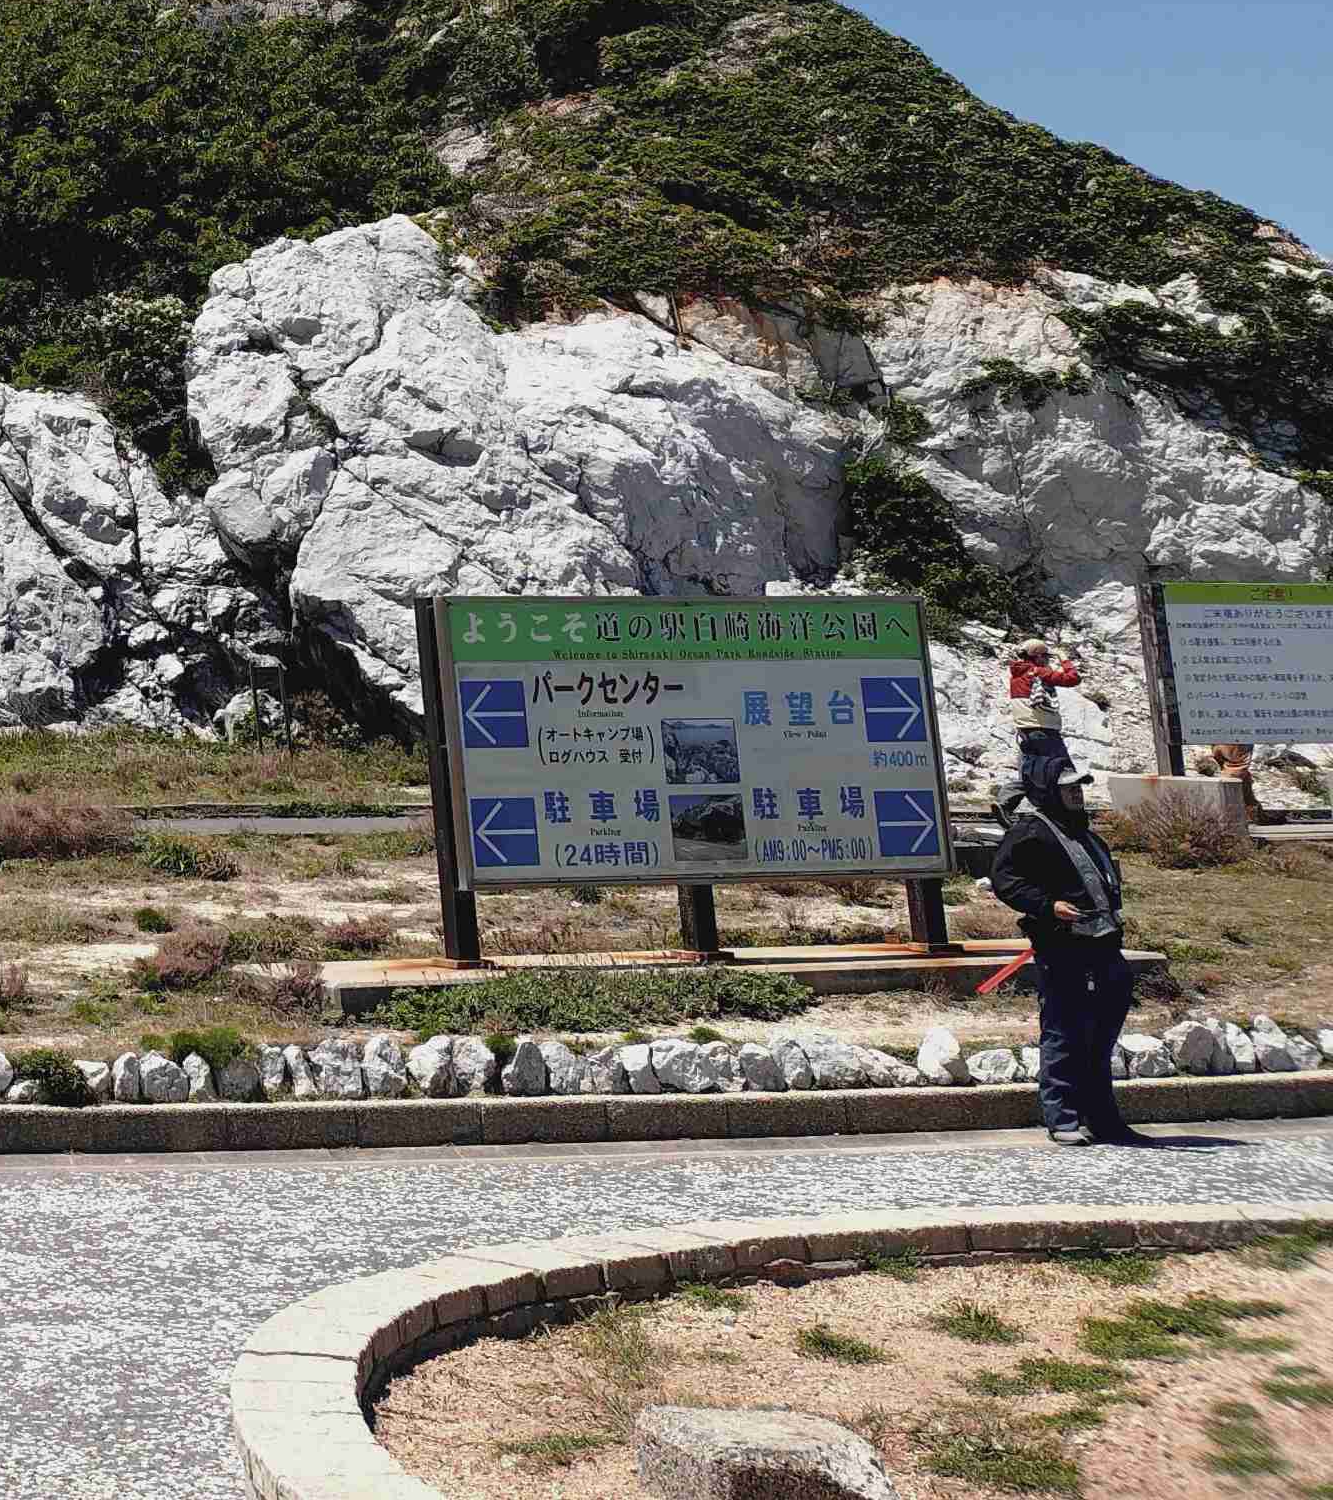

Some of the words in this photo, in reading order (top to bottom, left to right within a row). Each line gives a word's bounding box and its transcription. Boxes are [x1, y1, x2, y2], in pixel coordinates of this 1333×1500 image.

[462, 611, 910, 643] ようこそ道の駅白崎海洋公園へ
[532, 670, 684, 705] パークセンター
[741, 690, 855, 726] 展望台
[543, 789, 660, 824] 駐車場
[751, 785, 865, 820] 駐車場
